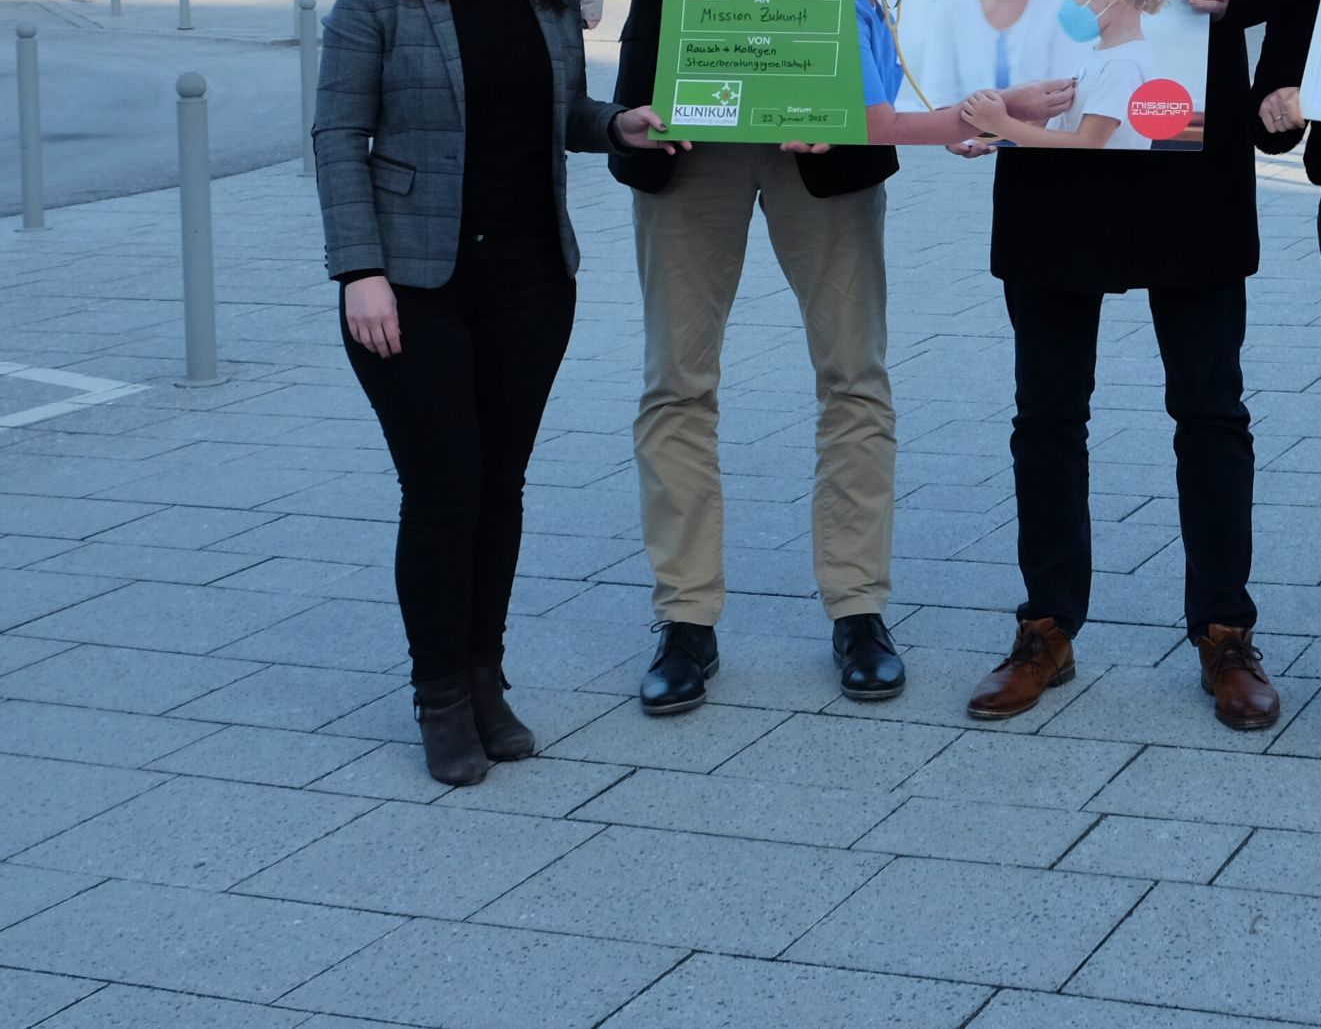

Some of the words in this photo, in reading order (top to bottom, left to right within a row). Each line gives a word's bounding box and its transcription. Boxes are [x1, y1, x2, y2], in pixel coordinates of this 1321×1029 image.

[700, 8, 751, 23] Mission
[760, 7, 808, 25] Zukunft
[747, 36, 771, 45] VON
[686, 43, 721, 53] Rausch
[734, 44, 777, 58] Kollegen
[1131, 101, 1189, 110] MISSION
[674, 106, 737, 118] KLINIKUM
